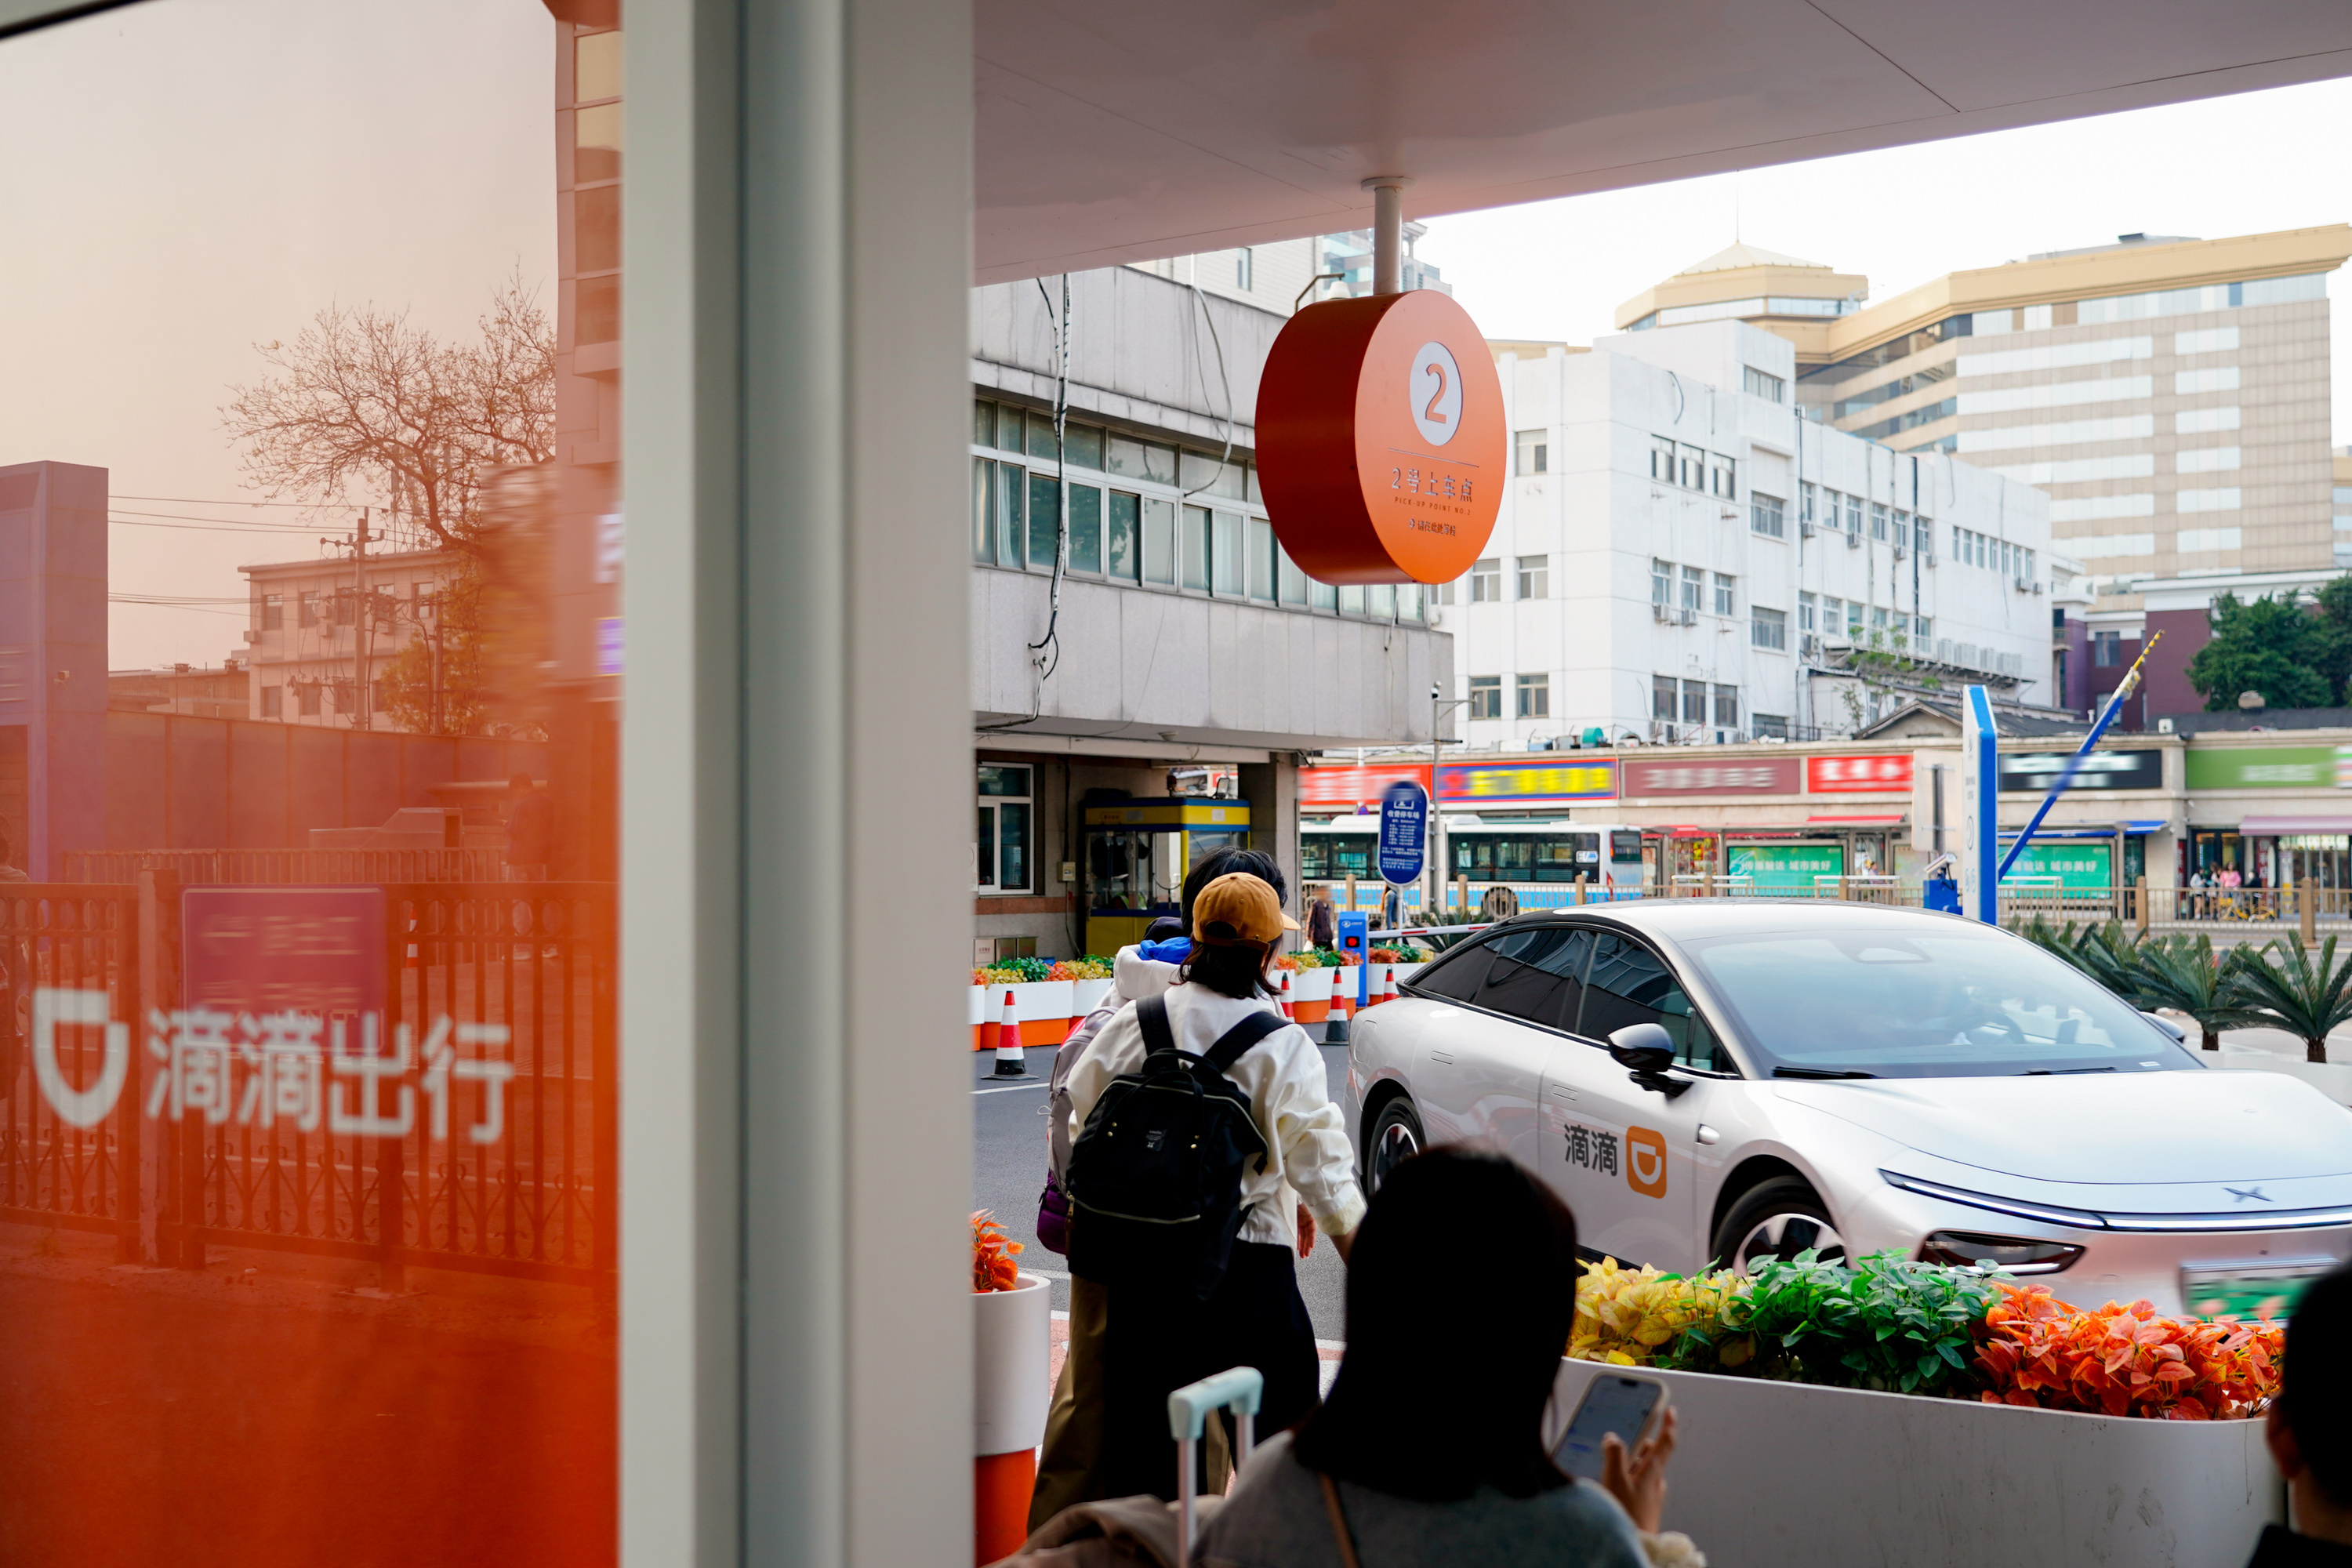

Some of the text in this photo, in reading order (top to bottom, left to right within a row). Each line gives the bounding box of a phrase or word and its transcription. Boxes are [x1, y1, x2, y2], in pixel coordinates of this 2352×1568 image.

[1425, 363, 1446, 424] 2
[1392, 467, 1472, 503] 2号上车点
[1394, 496, 1472, 517] PICK-UP POINT NO.2
[1417, 519, 1457, 537] 请在此处等候
[1387, 809, 1421, 820] 收费停车场
[147, 1007, 514, 1144] 滴滴出行
[1564, 1123, 1617, 1177] 滴滴
